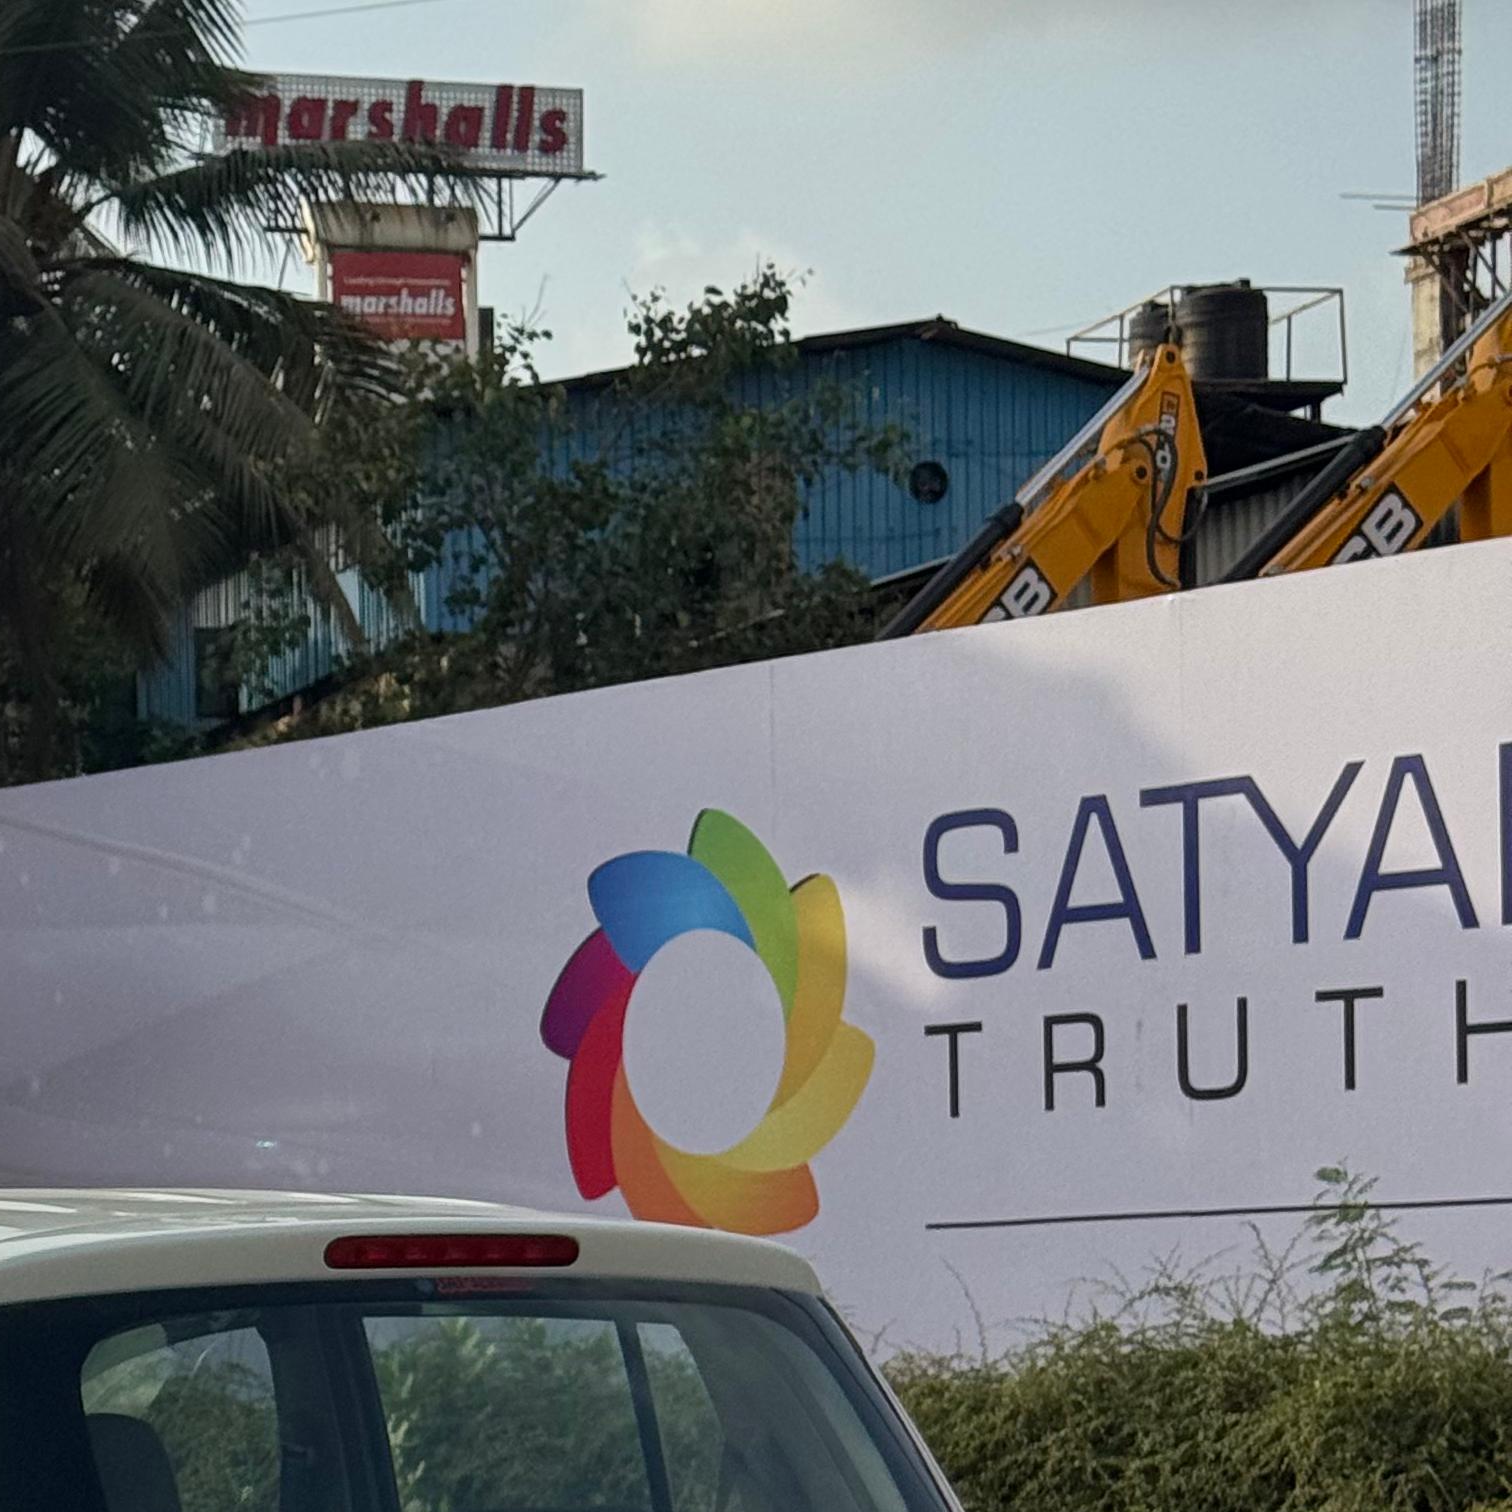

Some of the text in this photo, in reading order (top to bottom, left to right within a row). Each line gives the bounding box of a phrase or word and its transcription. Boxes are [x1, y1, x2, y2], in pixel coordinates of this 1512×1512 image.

[224, 80, 567, 155] marshalls
[340, 287, 456, 316] marshalls
[924, 979, 1512, 1119] TRUTH
